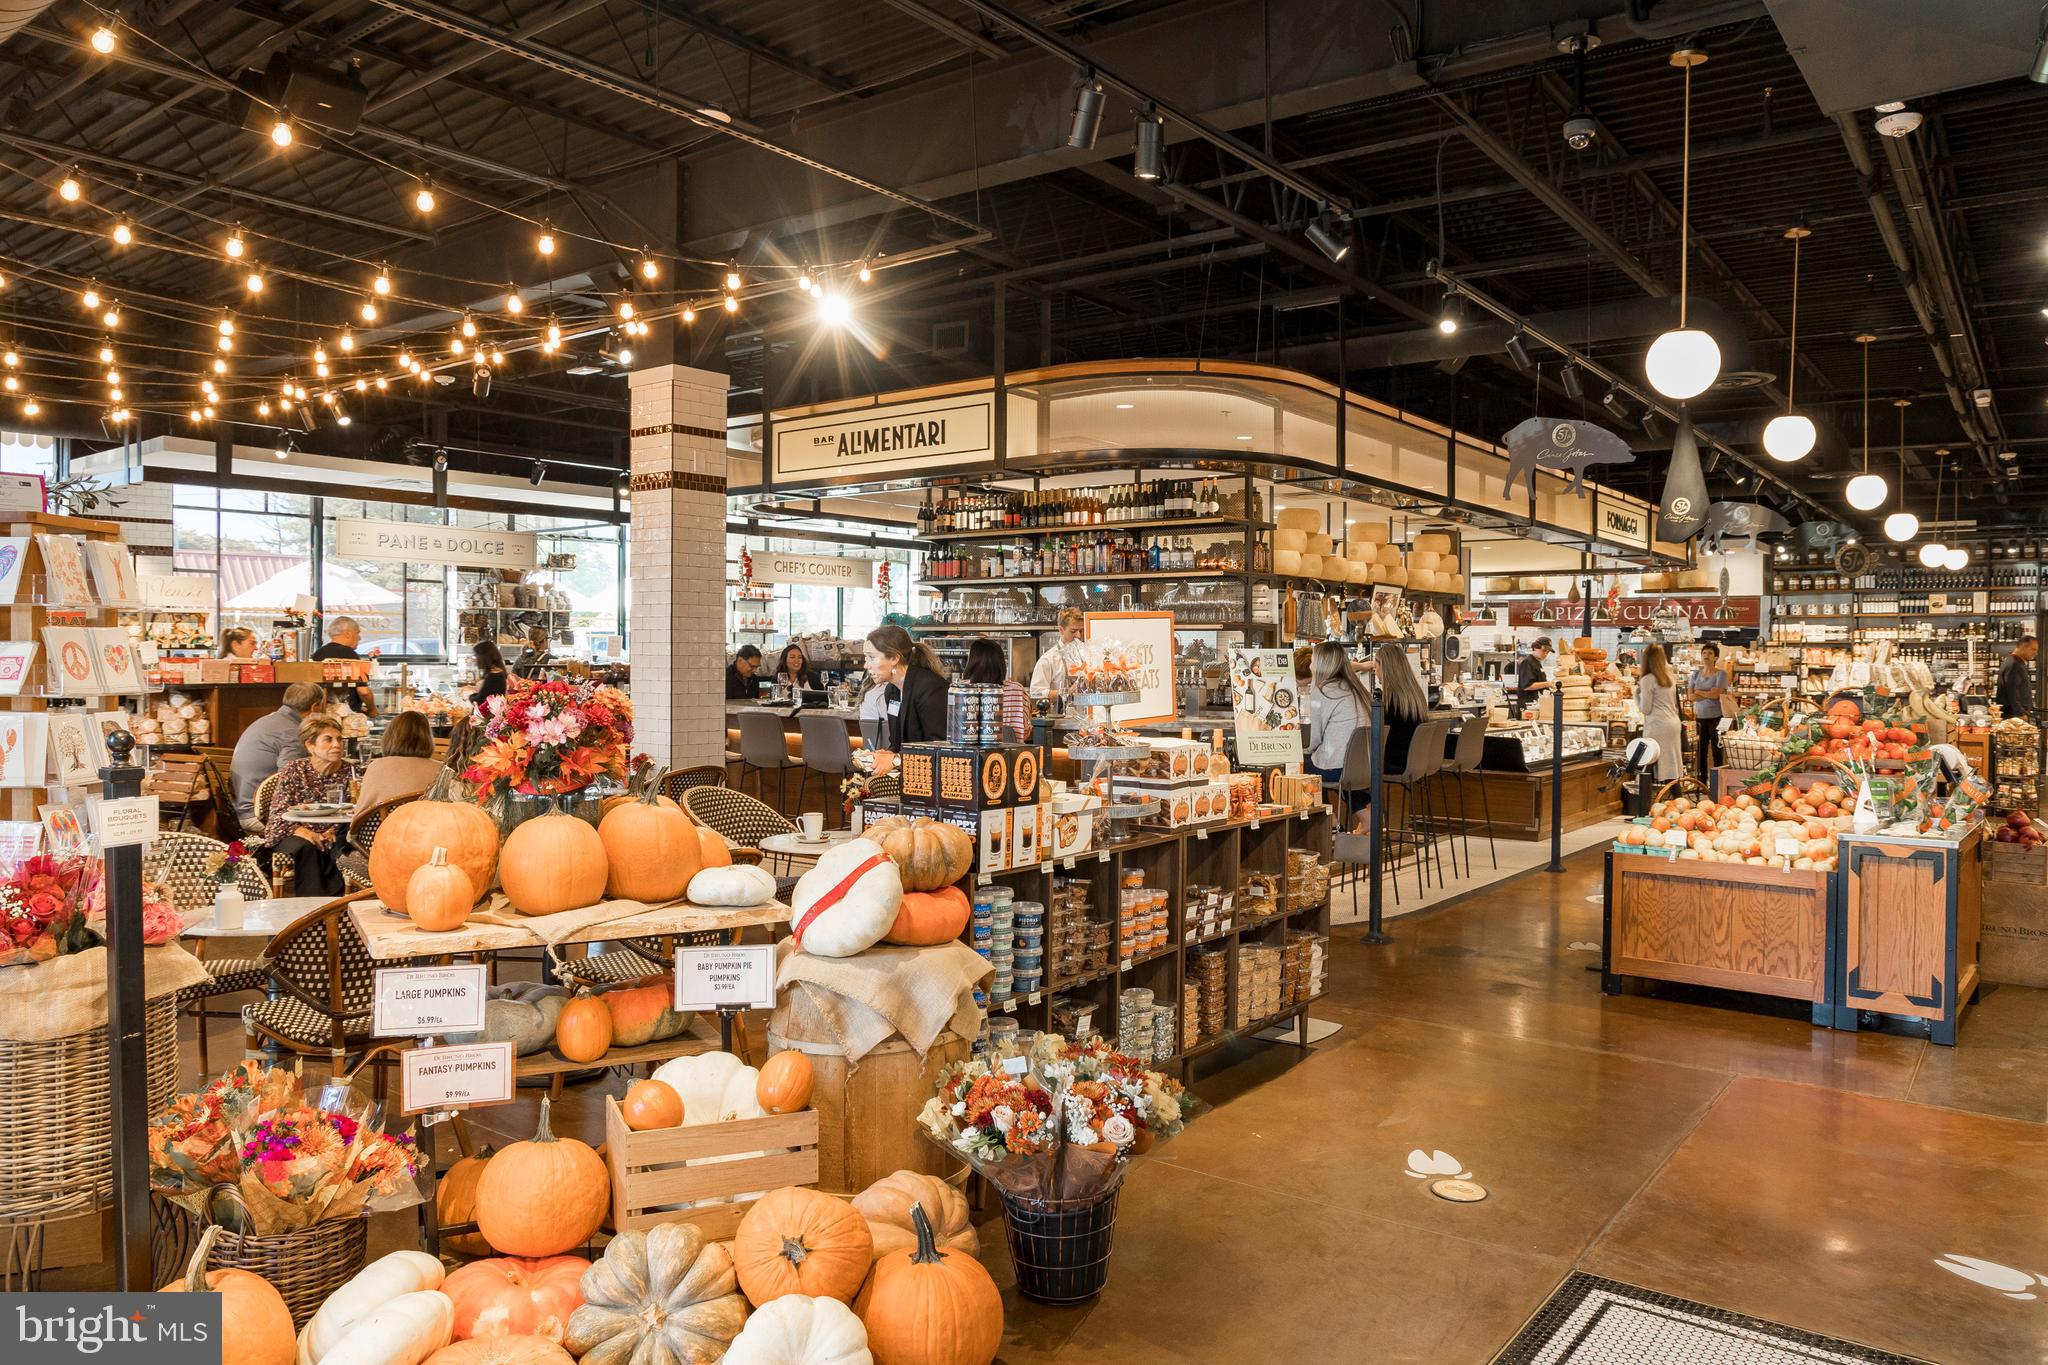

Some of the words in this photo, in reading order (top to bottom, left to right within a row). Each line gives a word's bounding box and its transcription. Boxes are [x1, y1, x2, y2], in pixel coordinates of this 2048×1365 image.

[814, 435, 834, 445] BAR
[837, 419, 946, 457] ALIMENTARI
[377, 533, 428, 551] PANE
[447, 538, 505, 556] DOLCE
[774, 560, 806, 574] CHEF'S
[809, 563, 852, 577] COUNTER
[1249, 742, 1259, 752] DI
[1261, 741, 1292, 751] BRUNO
[903, 754, 932, 762] HAPPY
[941, 756, 972, 766] HAPPY
[903, 782, 932, 790] COFFEE
[942, 785, 972, 793] COFFEE
[107, 813, 148, 822] BOUQUETS
[943, 818, 977, 829] HAPPY
[697, 962, 713, 971] BABY
[714, 961, 742, 970] PUMPKIN
[743, 961, 753, 970] PIE
[709, 974, 741, 982] PUMPKINS
[395, 989, 421, 1000] LARGE
[424, 987, 466, 999] PUMPKINS
[418, 1064, 453, 1077] FANTASY
[455, 1061, 497, 1073] PUMPKINS
